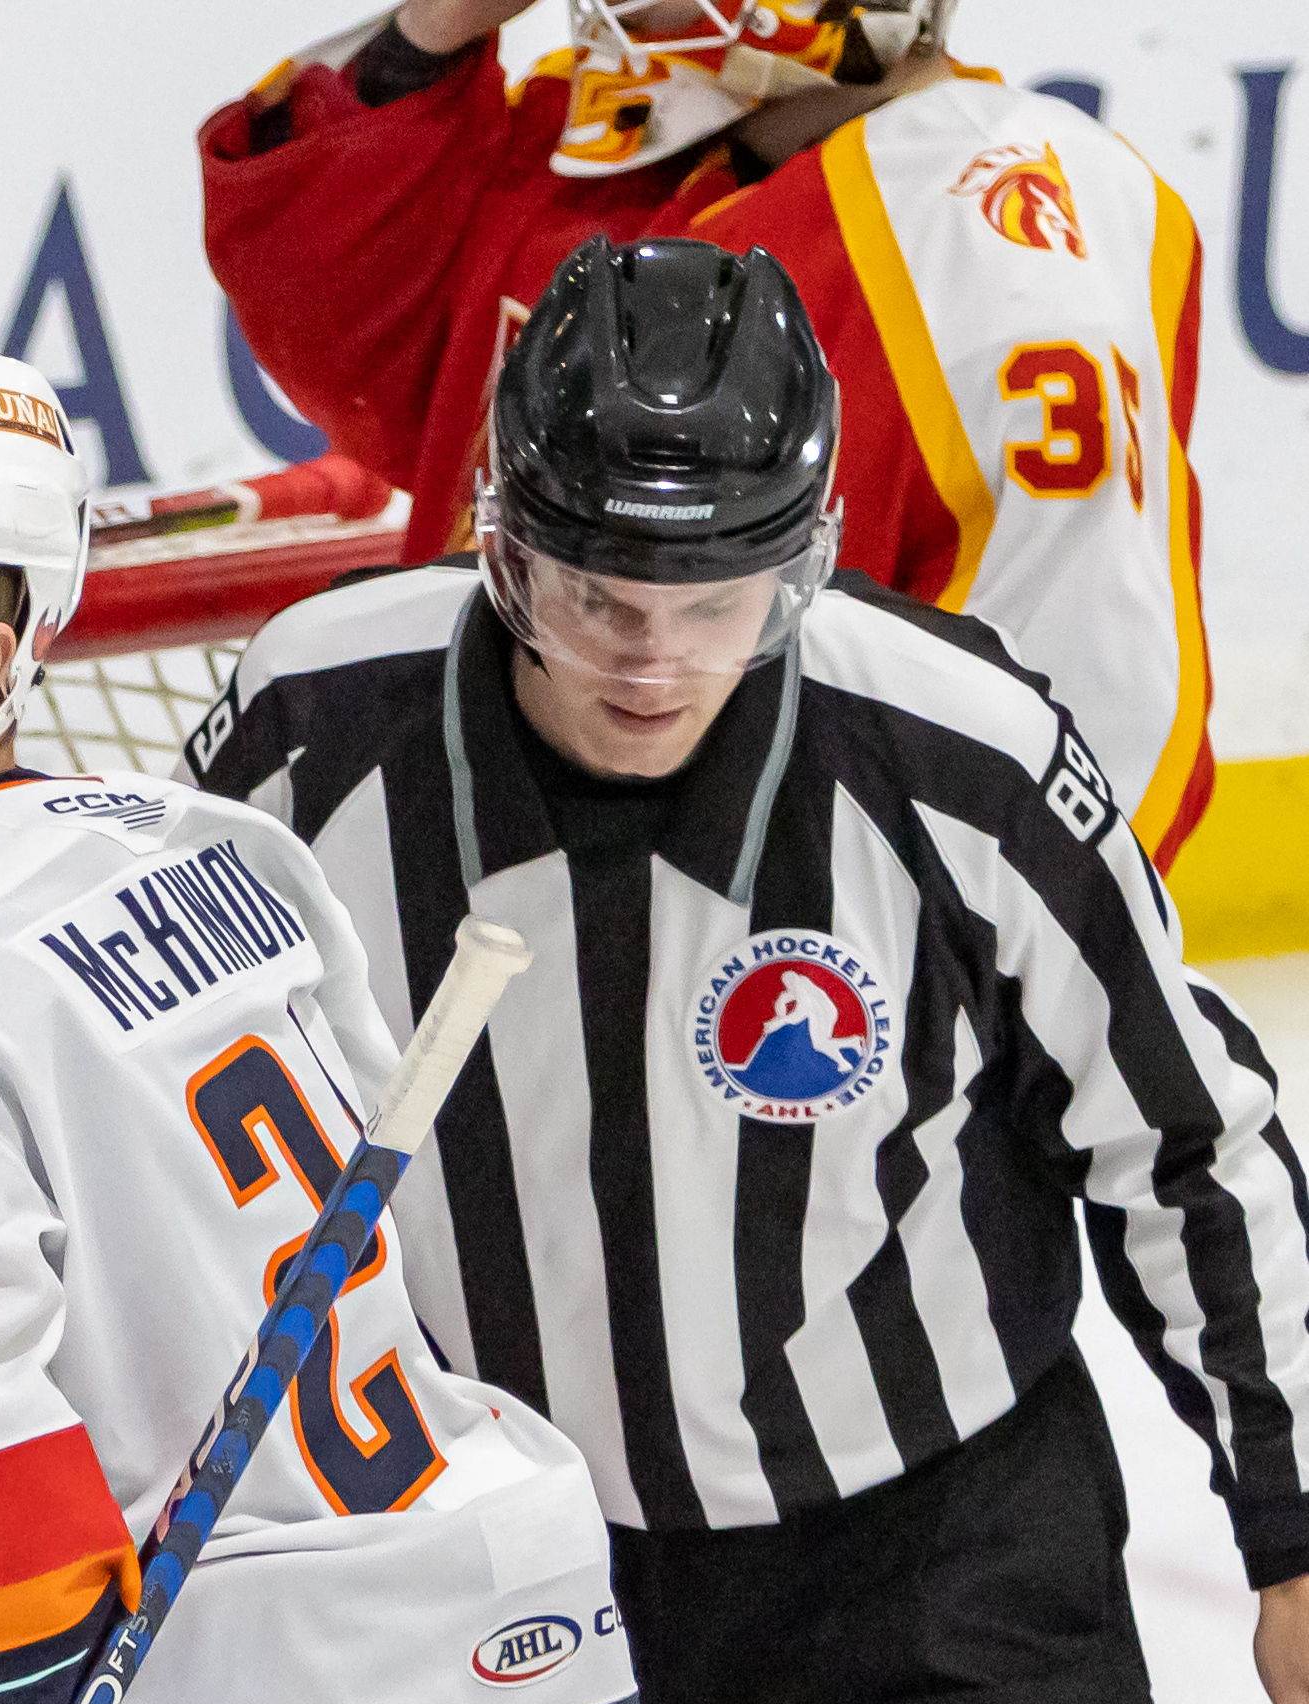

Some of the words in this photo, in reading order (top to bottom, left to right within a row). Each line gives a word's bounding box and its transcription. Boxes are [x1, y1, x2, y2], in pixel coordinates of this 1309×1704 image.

[604, 498, 715, 520] WARRIOR
[42, 792, 148, 814] CCM
[694, 956, 746, 1100] AMERICAN
[751, 937, 877, 990] HOCKEY
[835, 999, 891, 1107] LEAGUE
[185, 1000, 452, 1517] 2
[493, 1624, 563, 1673] AHL
[594, 1604, 624, 1638] C
